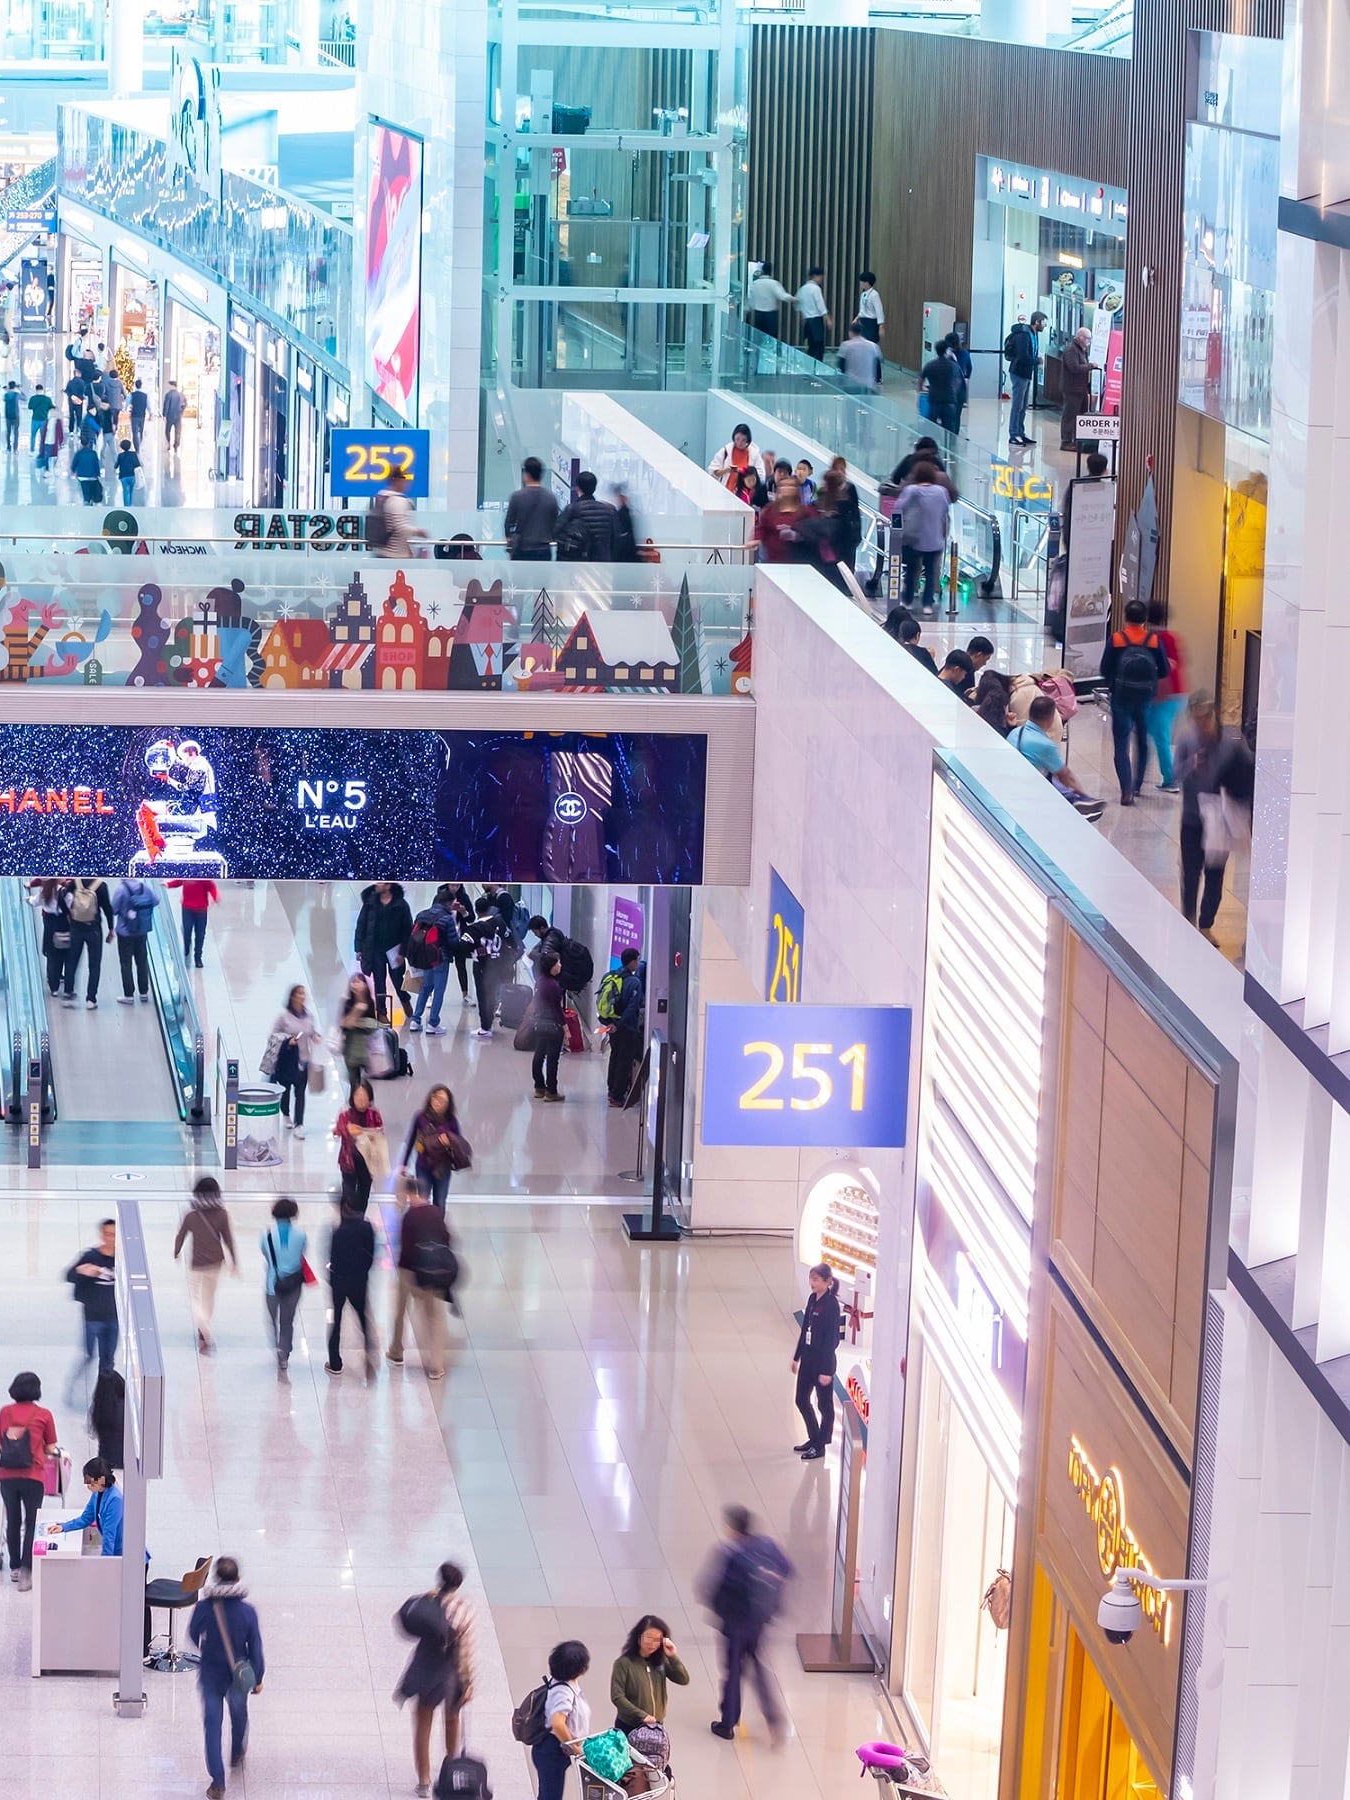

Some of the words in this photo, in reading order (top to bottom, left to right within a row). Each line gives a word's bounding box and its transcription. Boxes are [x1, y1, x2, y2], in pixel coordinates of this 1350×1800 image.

[1078, 419, 1110, 428] ORDER
[344, 444, 415, 481] 252
[382, 651, 414, 661] SHOP
[88, 663, 98, 685] SALE
[769, 912, 799, 1002] 251
[738, 1040, 868, 1112] 251
